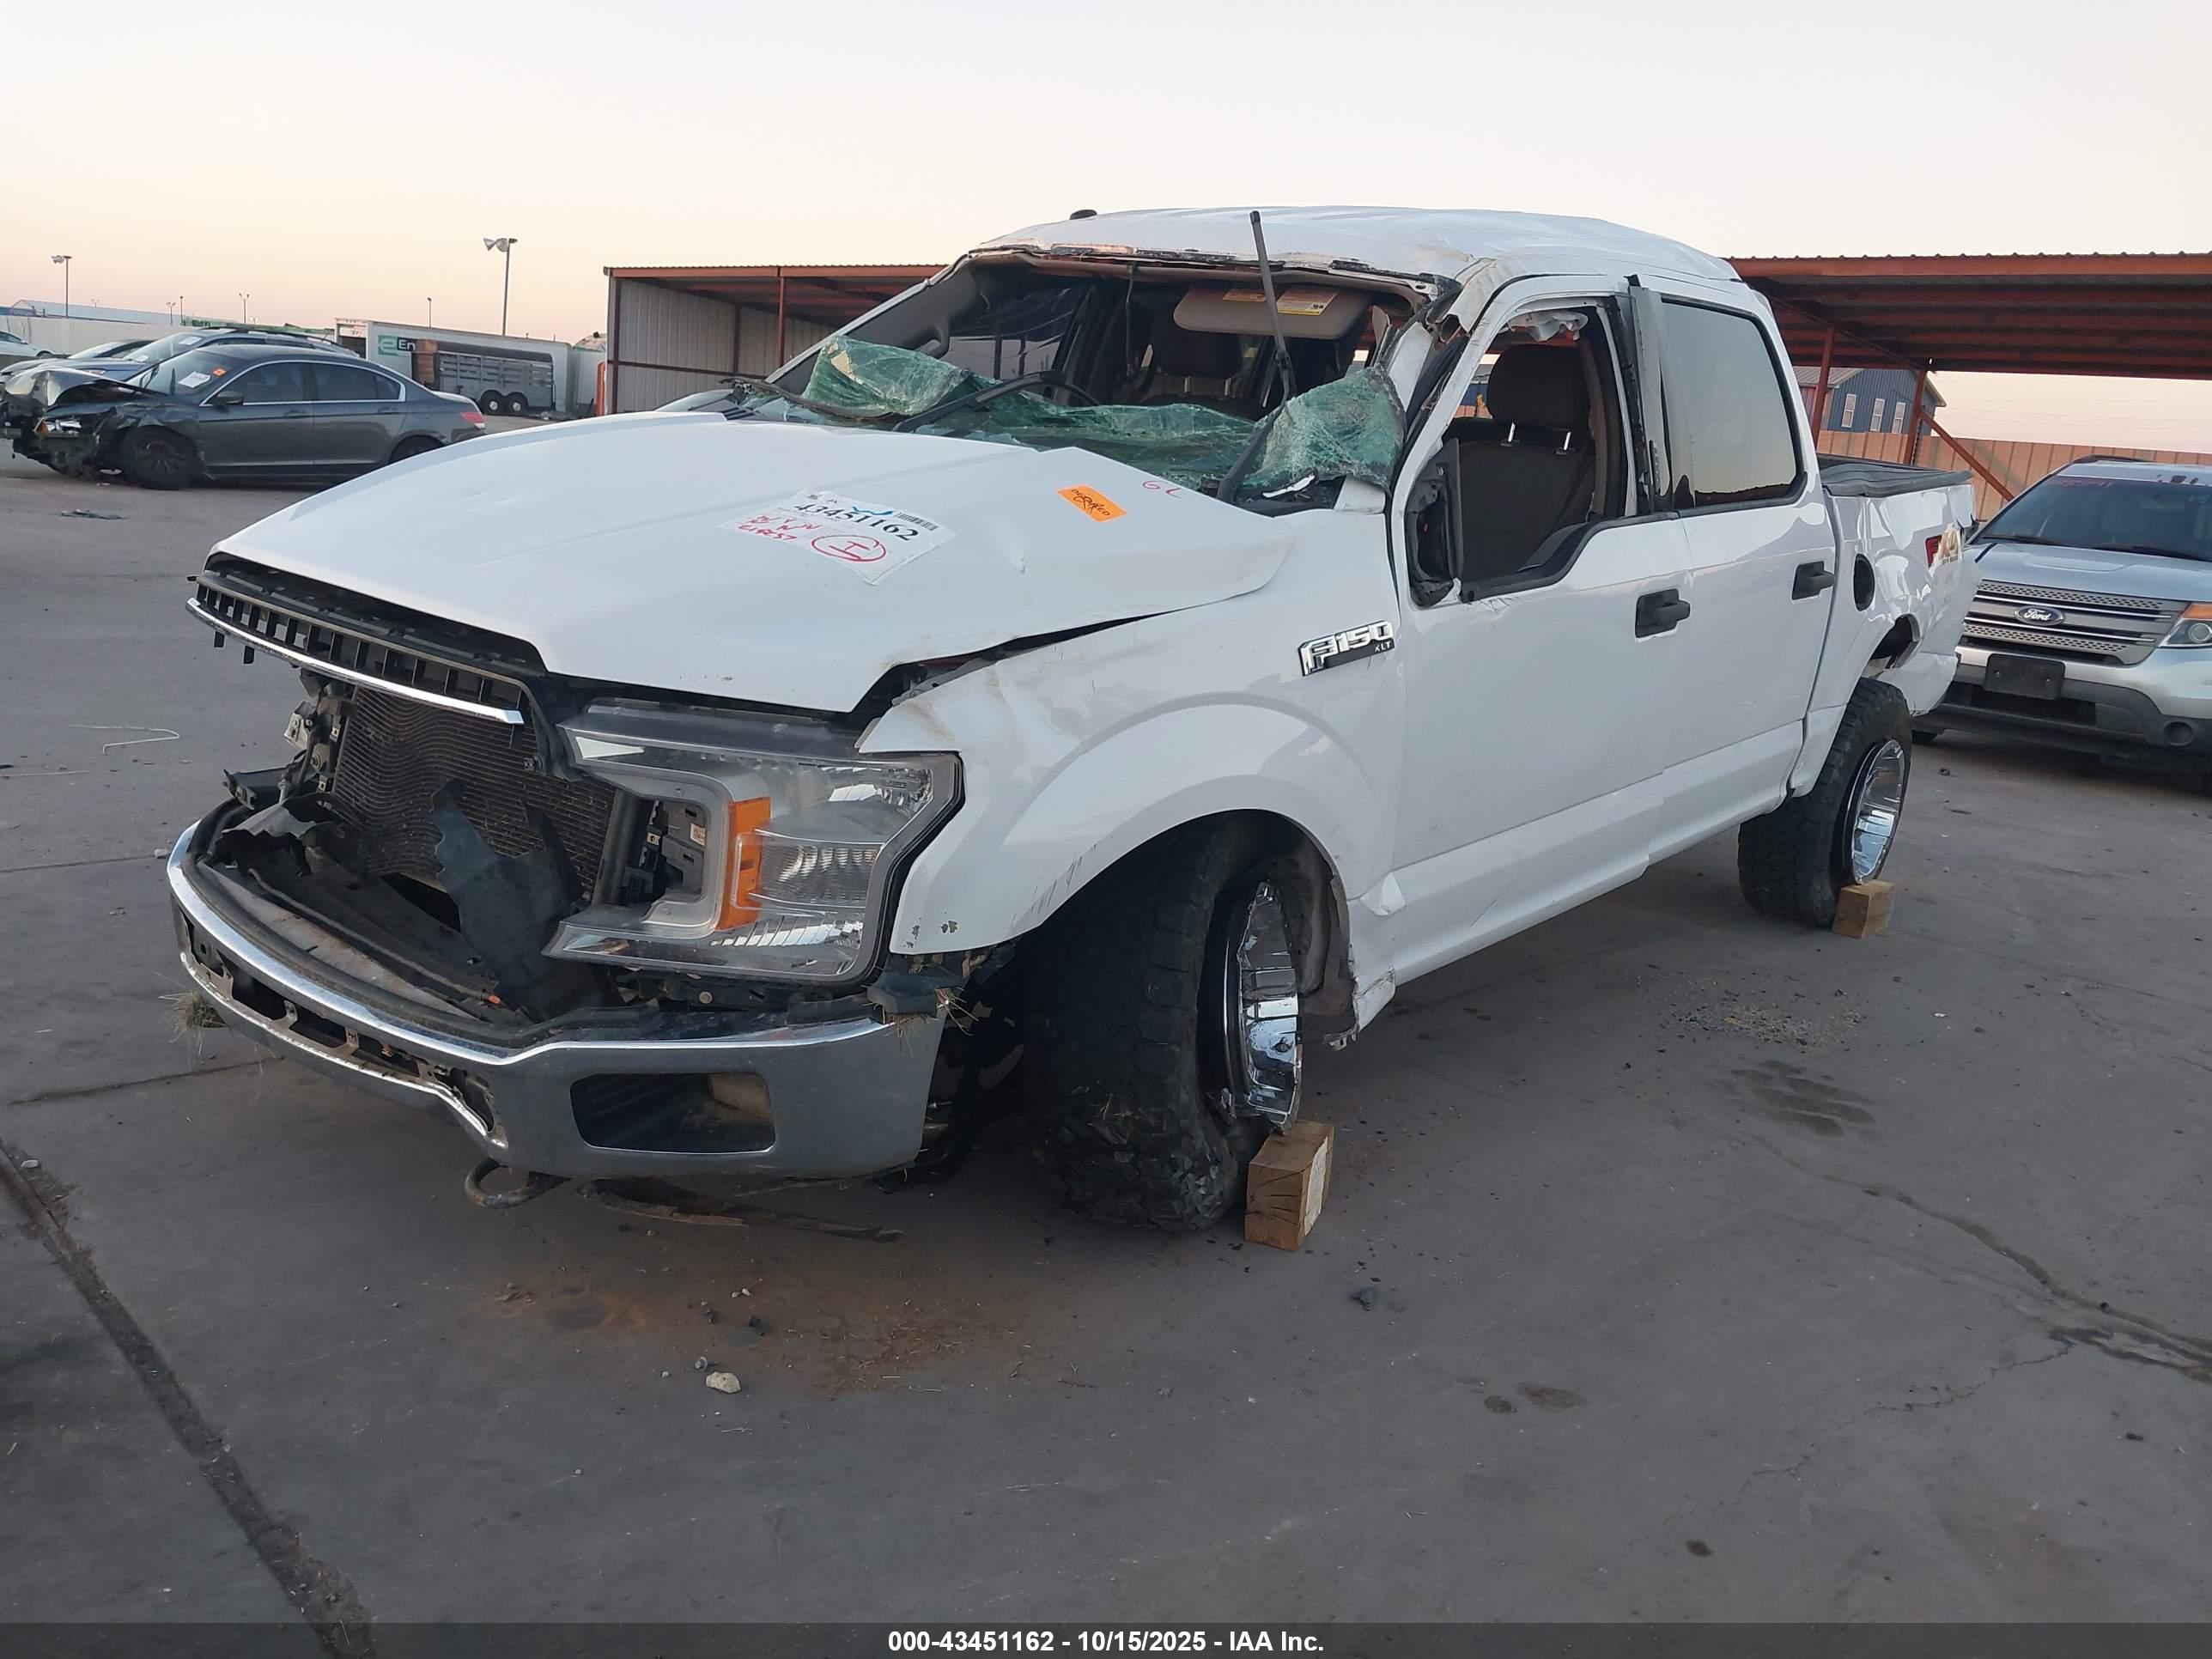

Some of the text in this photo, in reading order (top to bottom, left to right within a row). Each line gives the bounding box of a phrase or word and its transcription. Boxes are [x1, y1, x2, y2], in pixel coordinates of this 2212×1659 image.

[794, 503, 920, 541] 43451162
[2023, 608, 2052, 621] Ford
[1374, 640, 1392, 653] XLT
